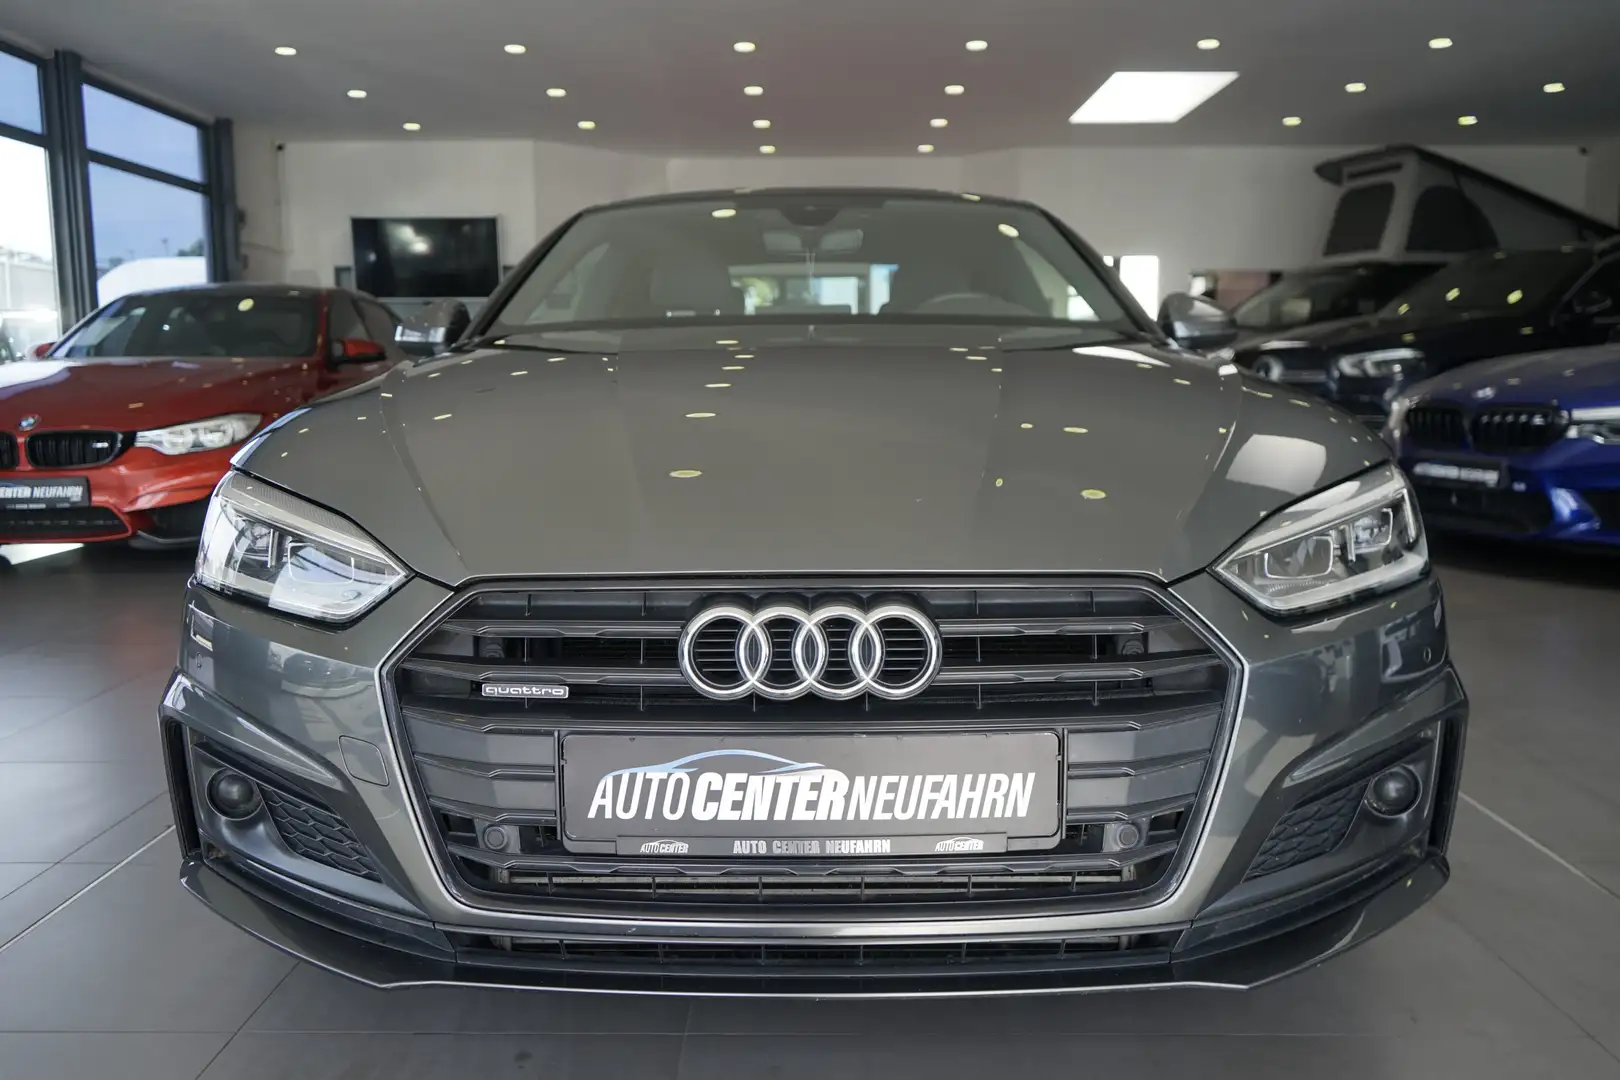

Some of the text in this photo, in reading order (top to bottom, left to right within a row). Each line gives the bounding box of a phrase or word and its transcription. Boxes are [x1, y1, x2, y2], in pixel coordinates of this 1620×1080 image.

[485, 686, 564, 696] quattro
[587, 769, 1036, 821] AUTO CENTER NEUFAHRN
[733, 839, 891, 854] AUTO CENTER NEUFAHRN
